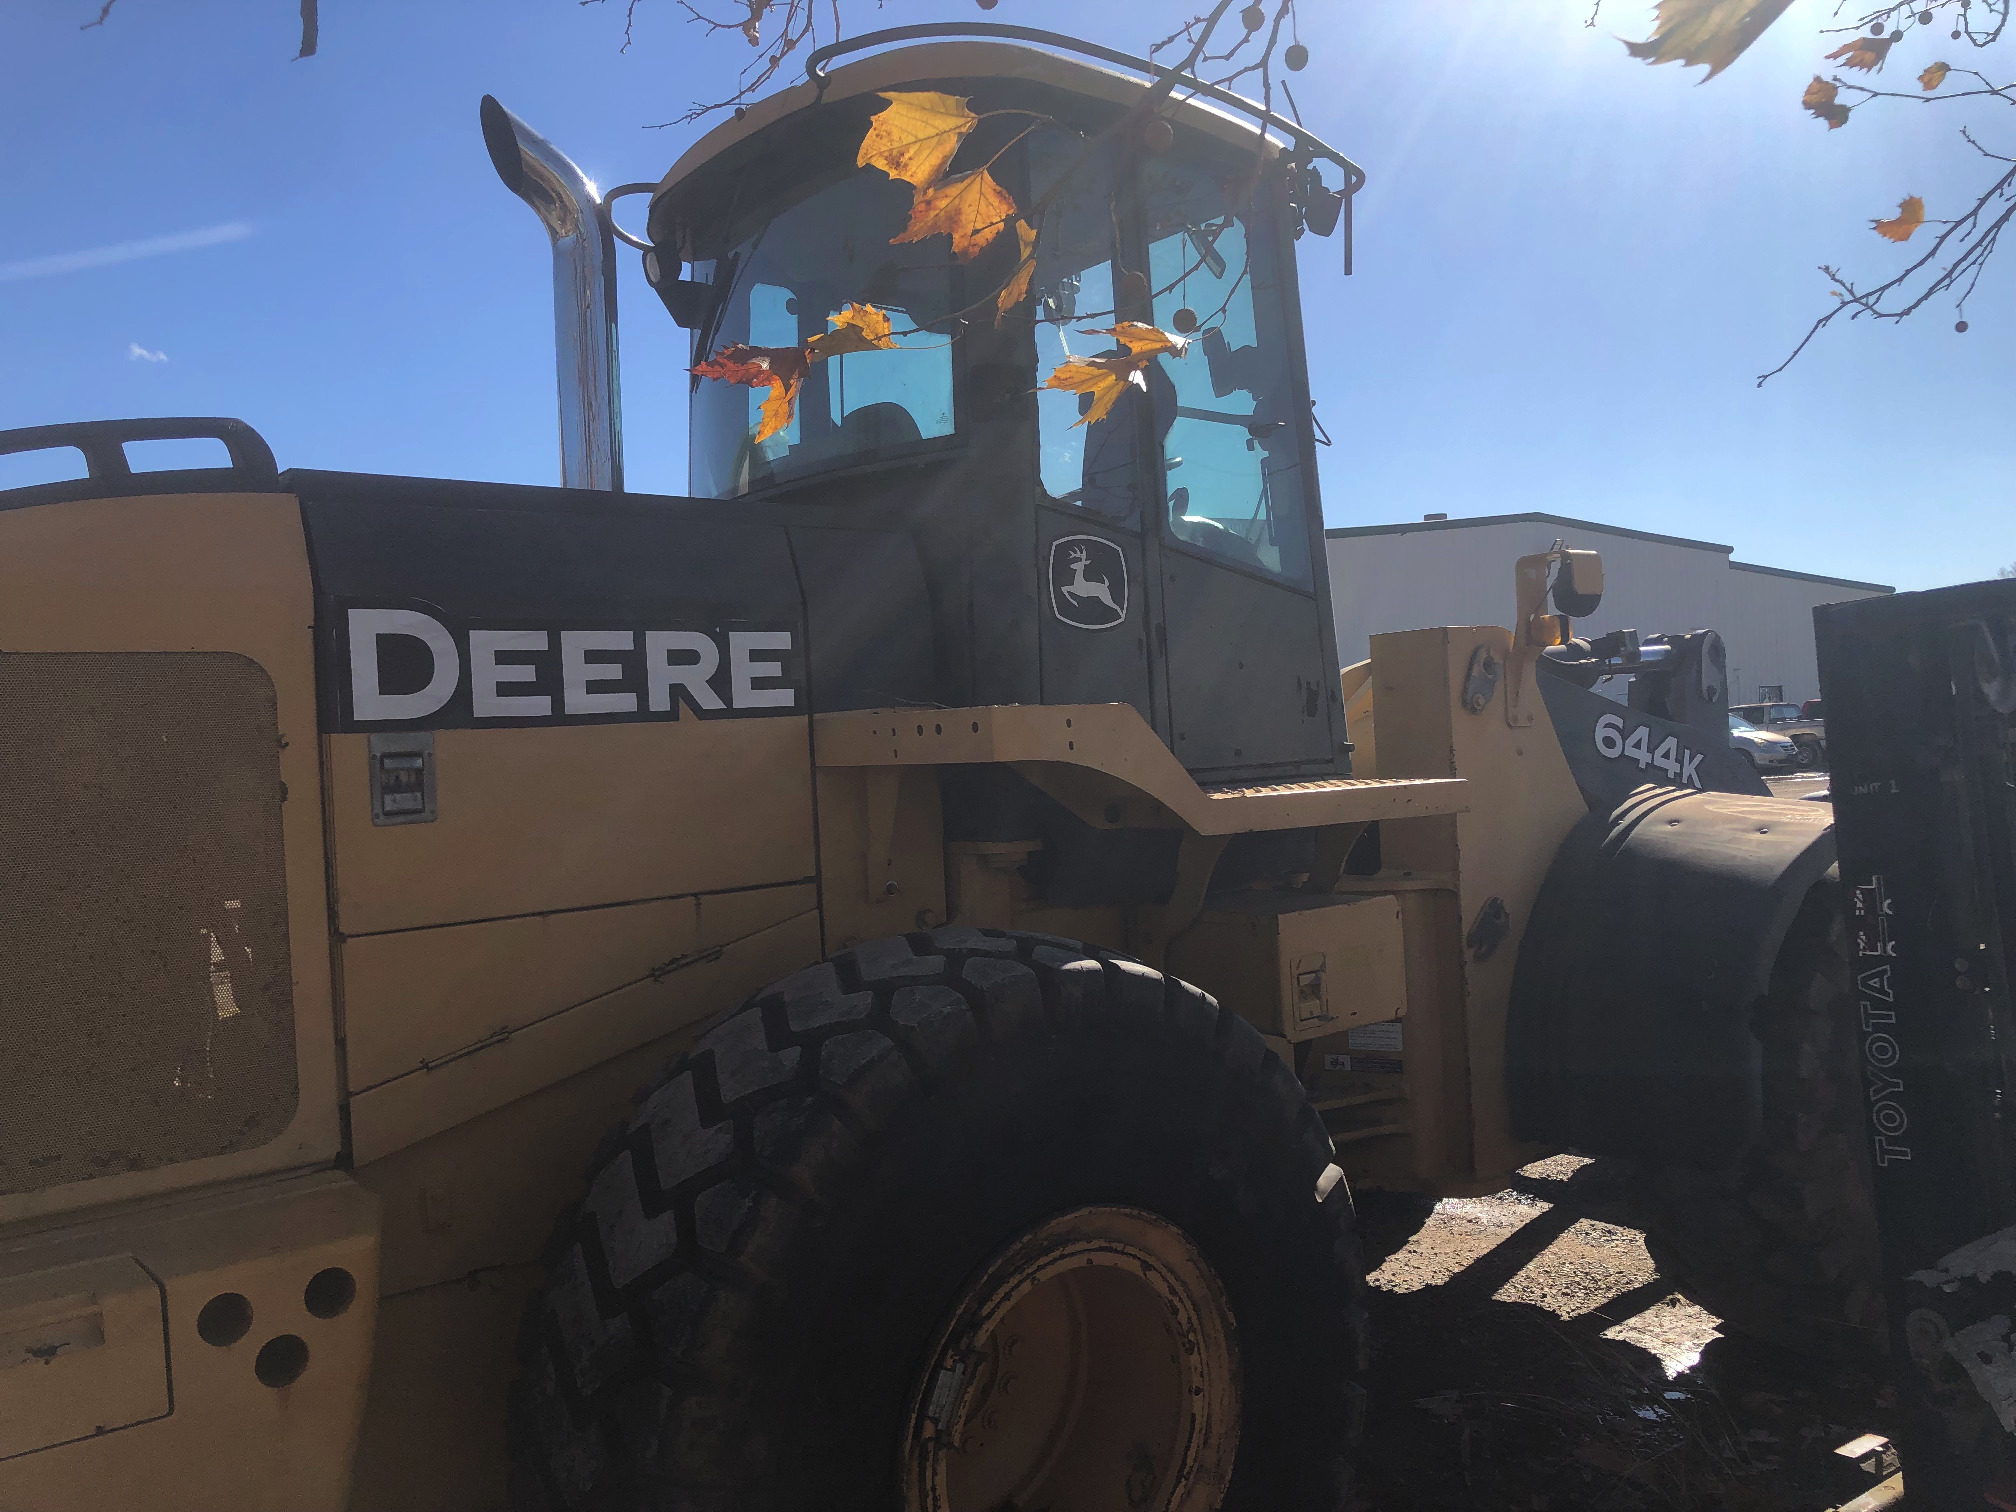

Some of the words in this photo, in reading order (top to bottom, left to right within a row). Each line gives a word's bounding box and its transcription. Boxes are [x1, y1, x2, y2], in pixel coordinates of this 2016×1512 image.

[348, 608, 795, 721] DEERE
[1596, 713, 1704, 789] 644K
[1857, 964, 1911, 1167] TOYOTA
